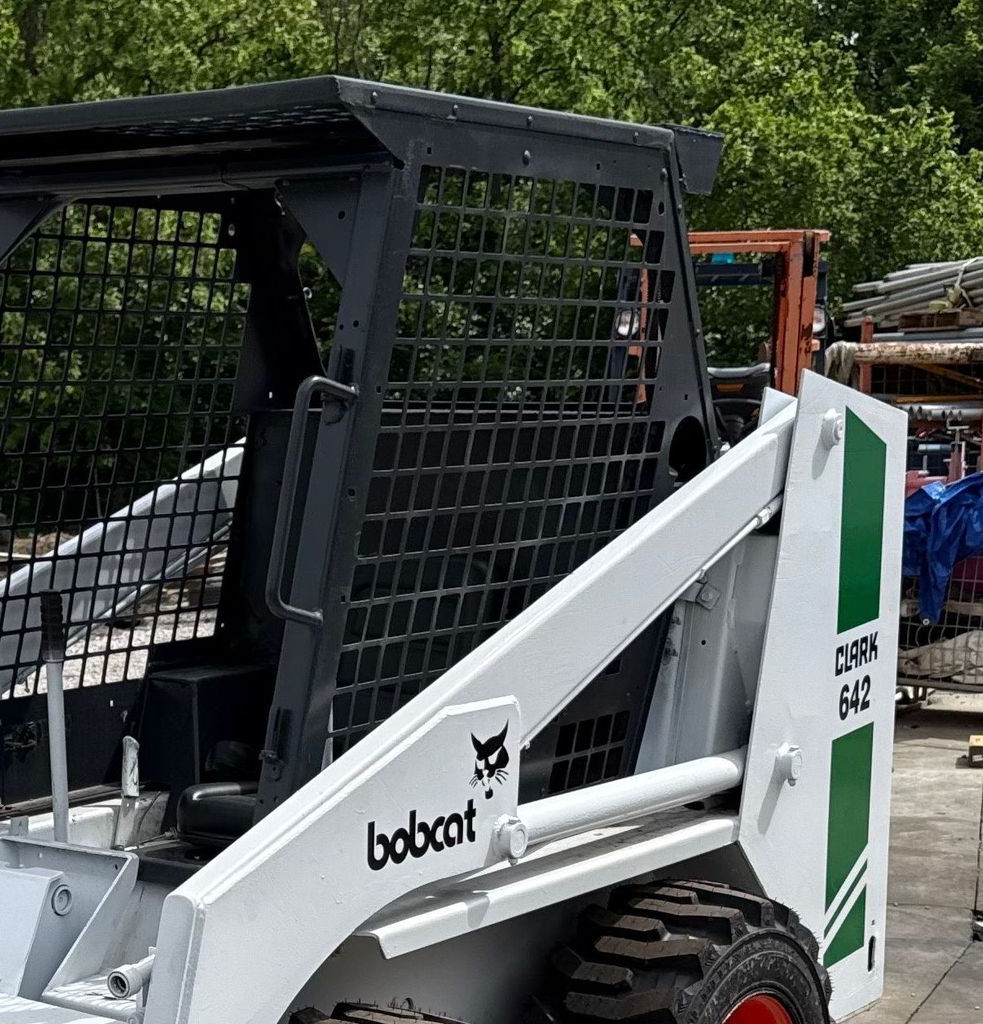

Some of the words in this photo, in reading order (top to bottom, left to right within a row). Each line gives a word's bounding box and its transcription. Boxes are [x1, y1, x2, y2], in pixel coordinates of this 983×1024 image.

[835, 631, 878, 677] CLARK
[838, 674, 871, 721] 642
[367, 798, 476, 871] bobcat
